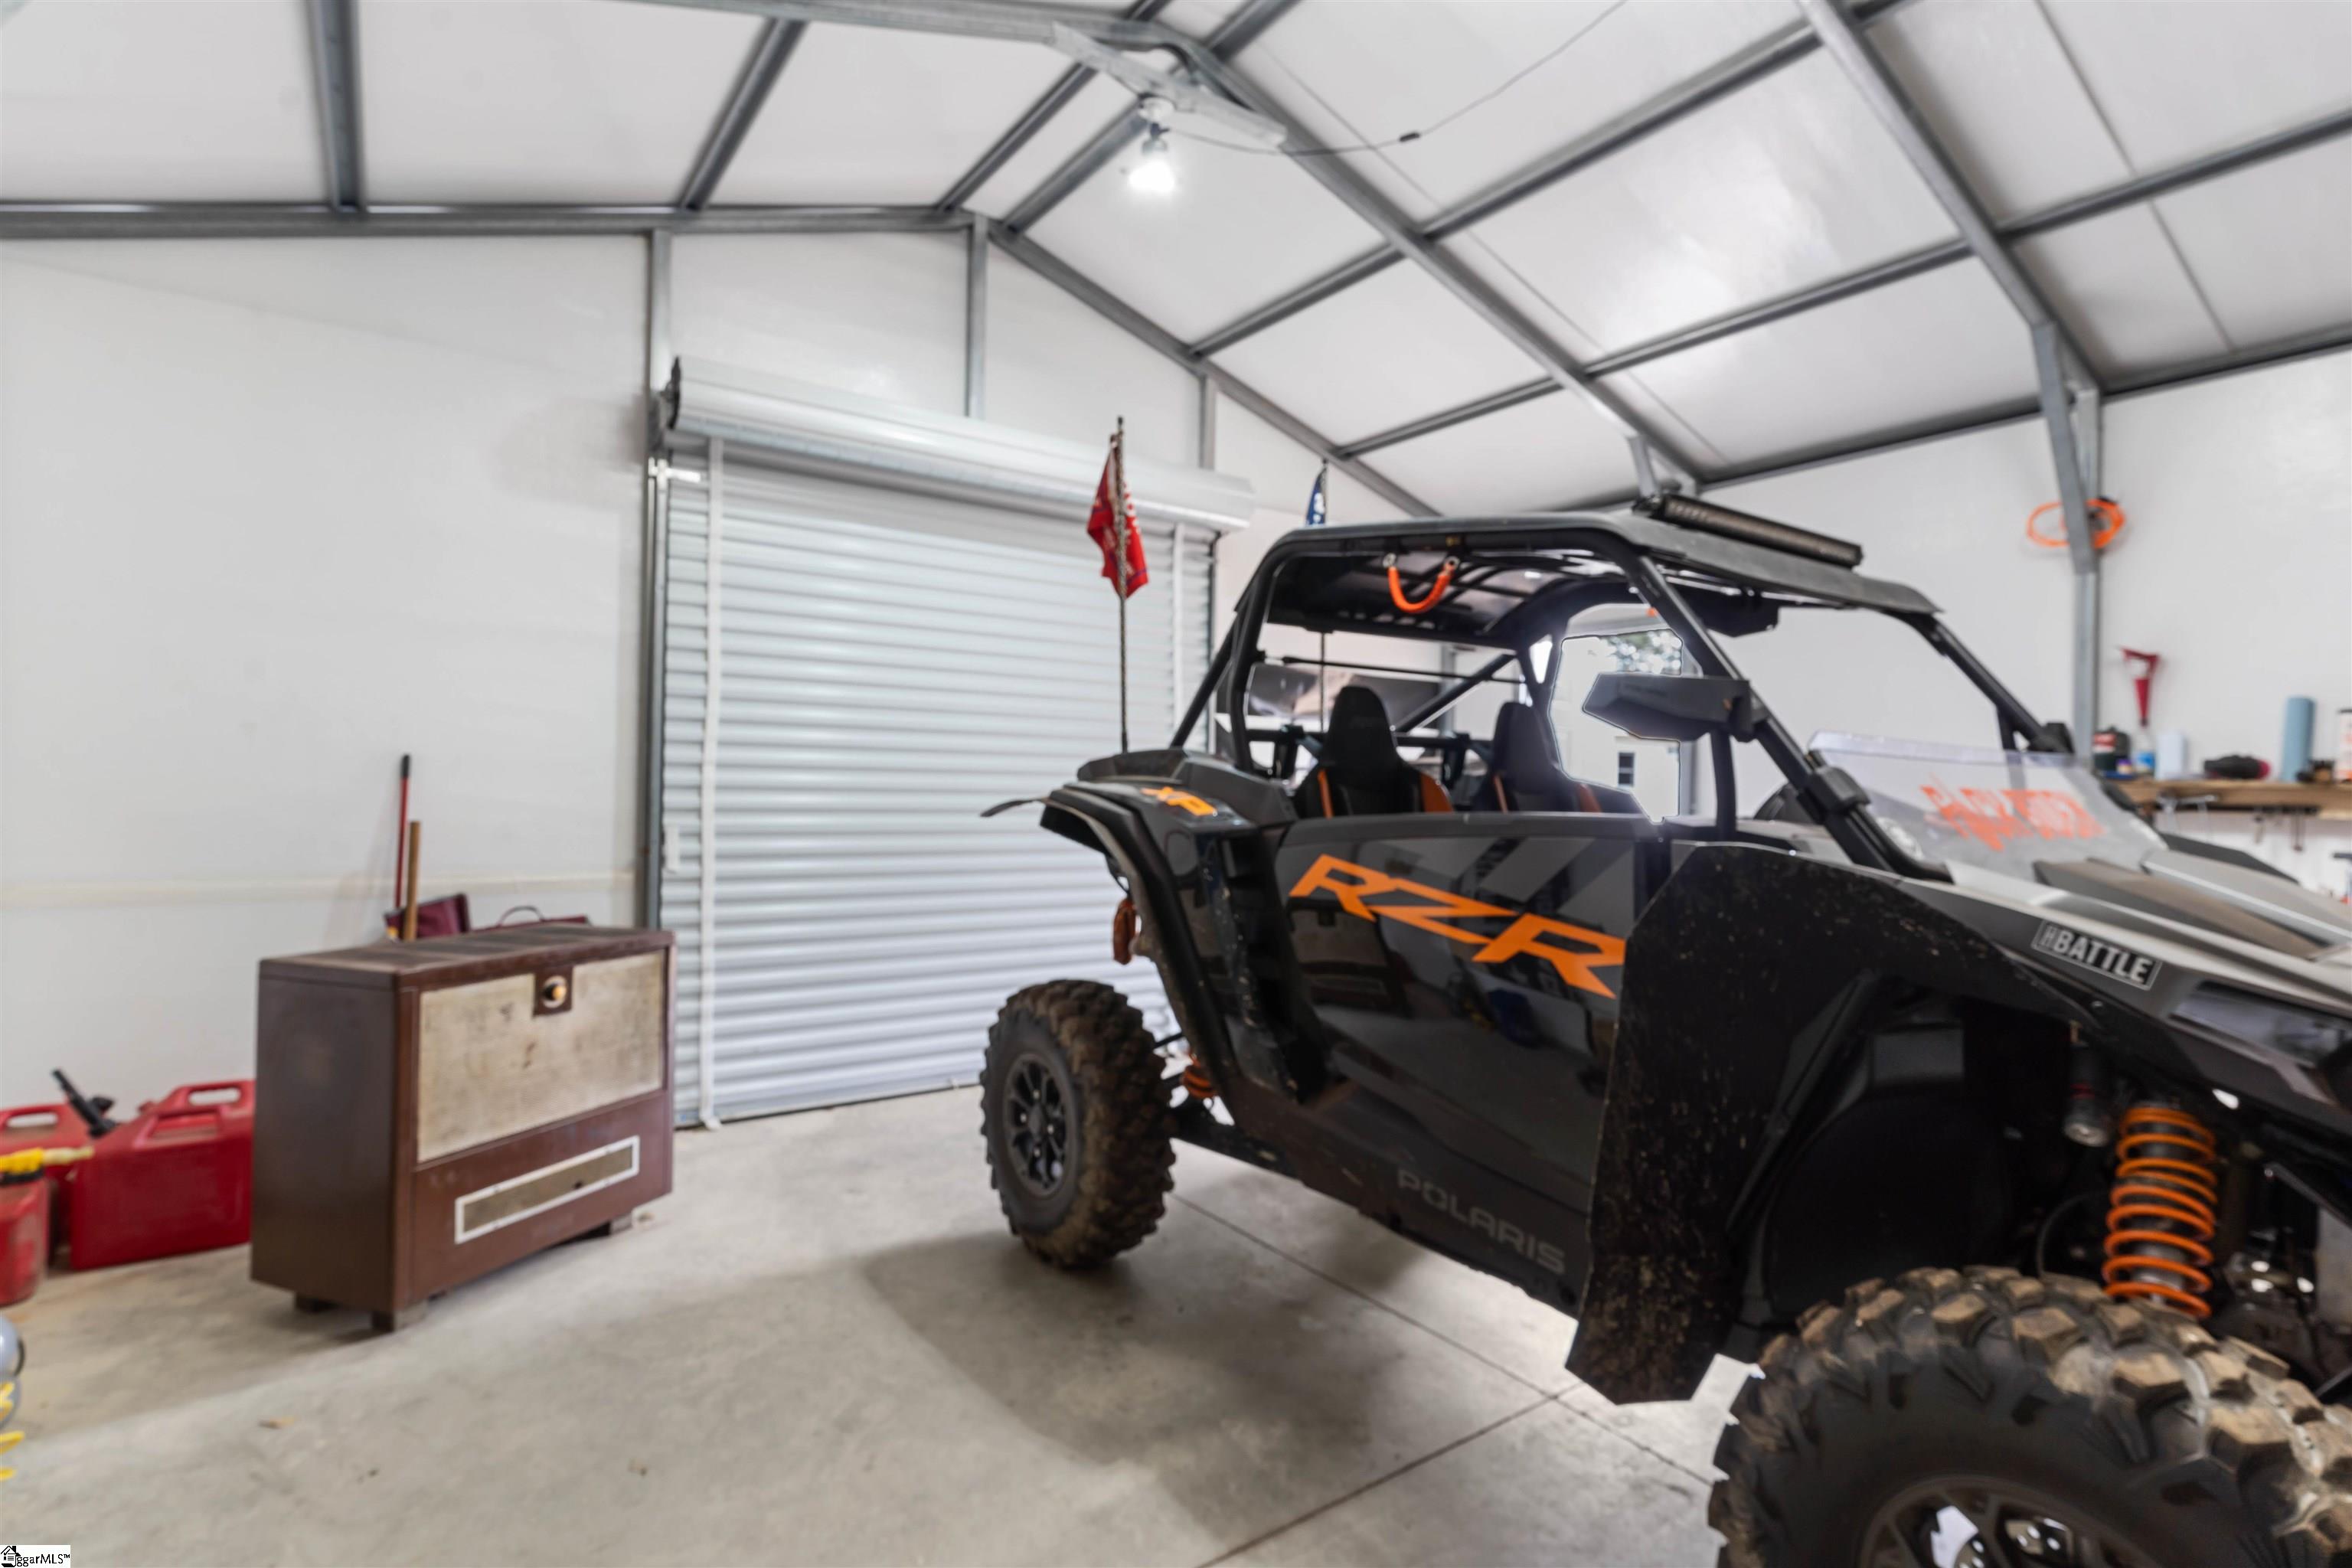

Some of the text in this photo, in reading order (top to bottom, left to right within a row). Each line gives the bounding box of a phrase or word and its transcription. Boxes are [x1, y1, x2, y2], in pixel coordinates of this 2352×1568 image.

[1289, 854, 1626, 998] RZR
[2053, 929, 2152, 983] BATTLE
[1397, 1168, 1565, 1275] POLARIS
